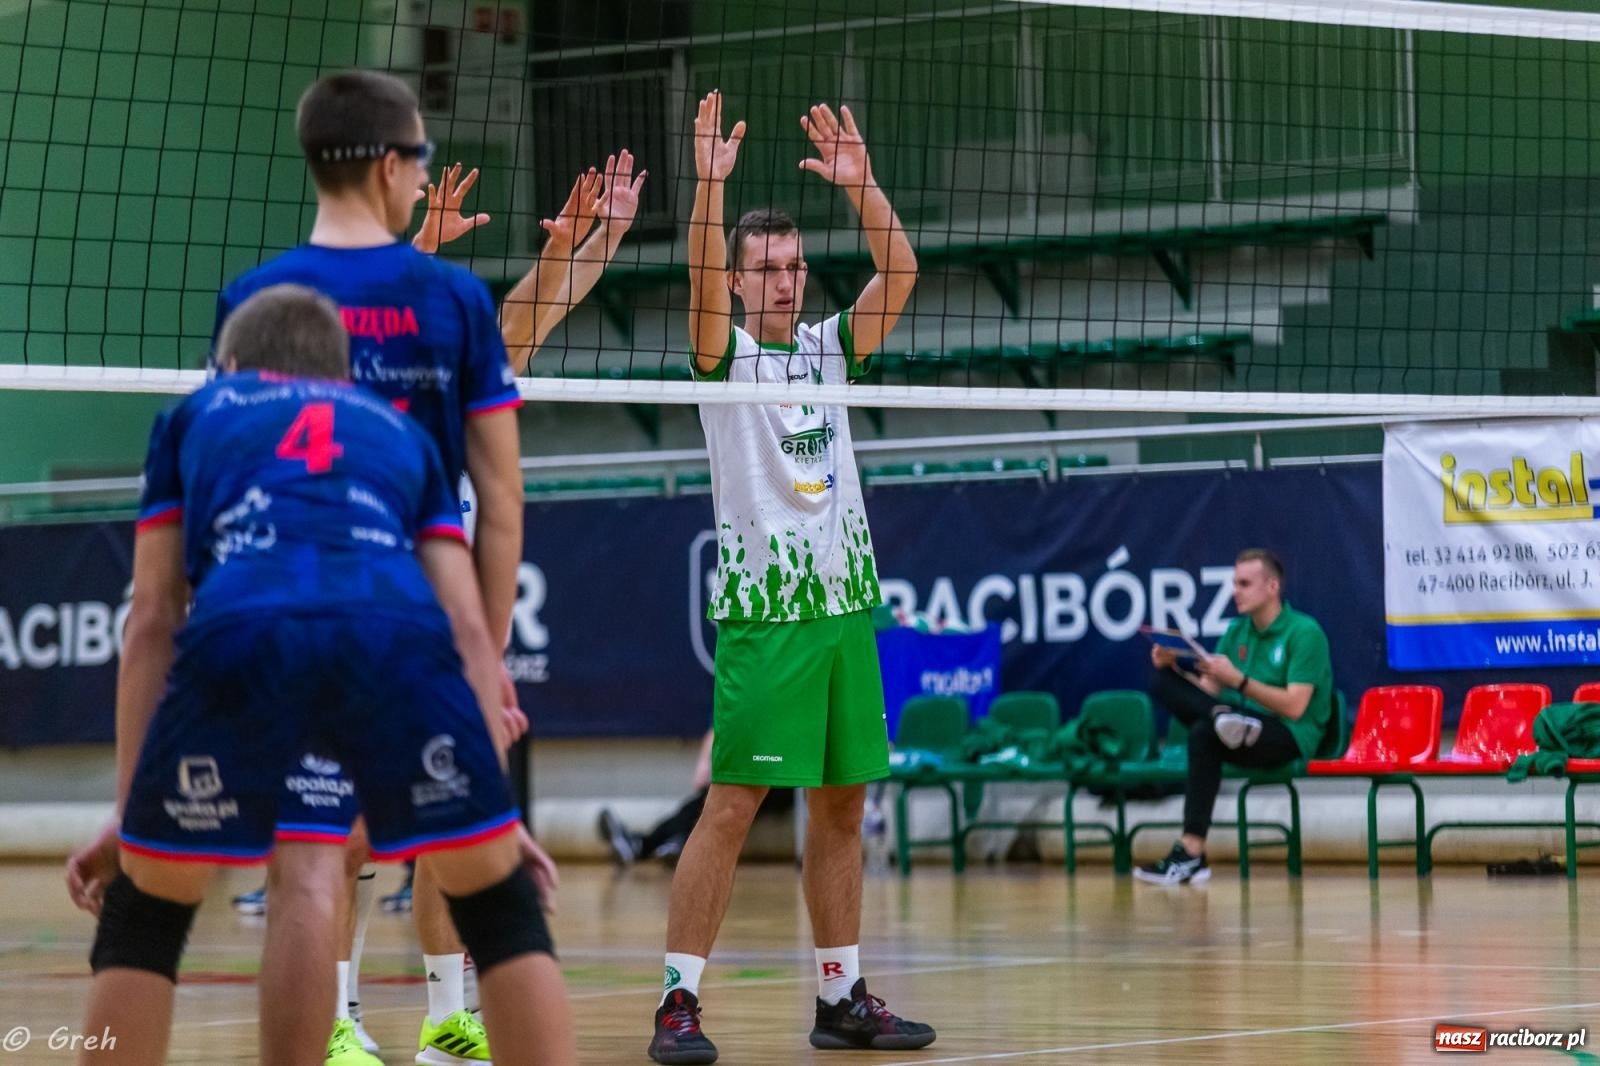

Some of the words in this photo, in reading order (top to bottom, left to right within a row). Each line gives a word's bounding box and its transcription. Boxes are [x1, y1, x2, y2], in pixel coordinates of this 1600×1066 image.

[275, 402, 344, 474] 4
[1440, 451, 1589, 512] instal
[1406, 546, 1430, 567] tel.
[1434, 545, 1451, 566] 32
[1457, 544, 1486, 564] 414
[1547, 541, 1580, 563] 502
[1417, 572, 1475, 595] 47-400
[1479, 568, 1553, 592] Racibórz,
[823, 961, 845, 976] R
